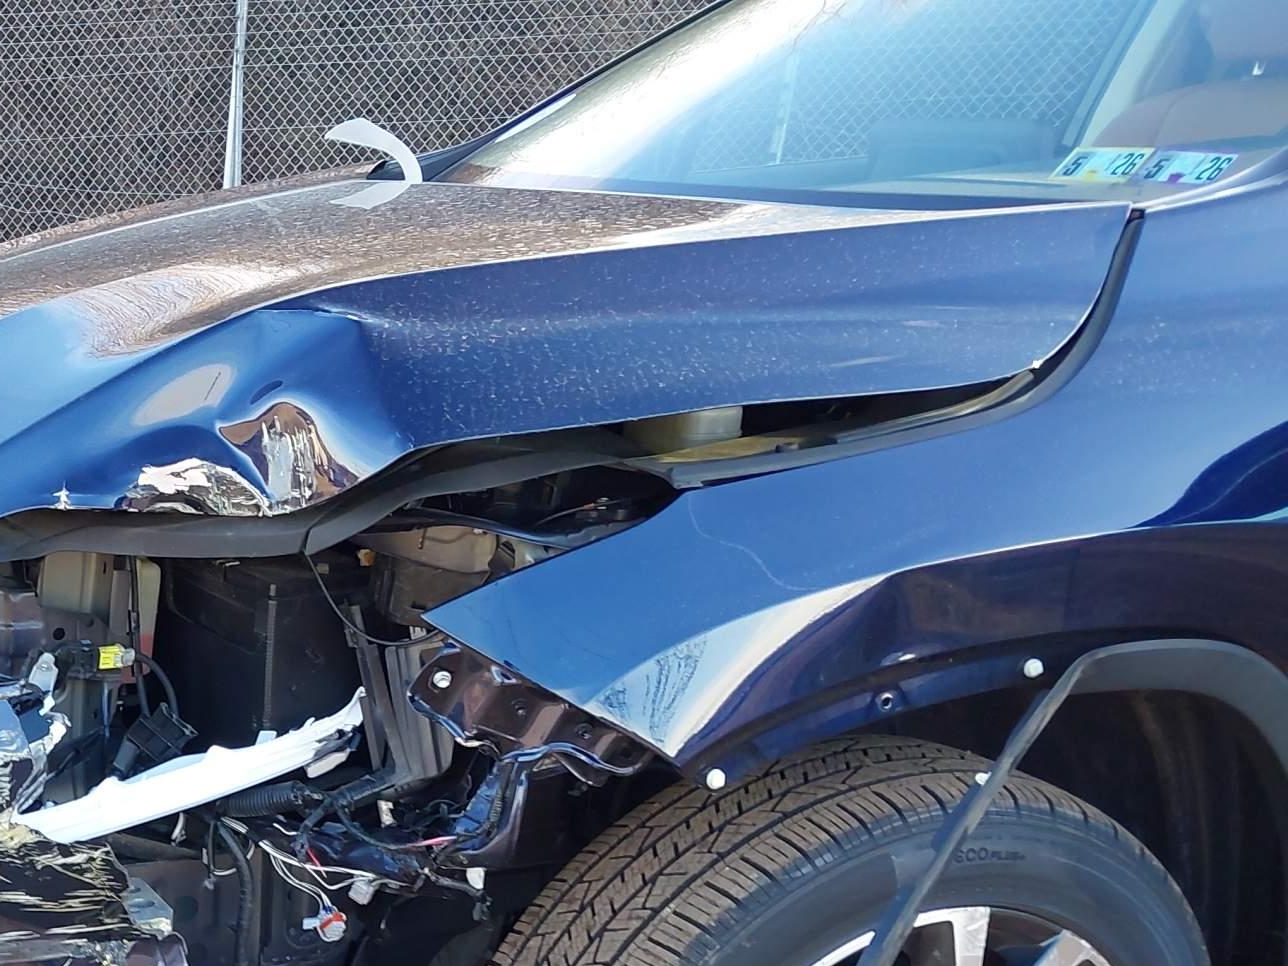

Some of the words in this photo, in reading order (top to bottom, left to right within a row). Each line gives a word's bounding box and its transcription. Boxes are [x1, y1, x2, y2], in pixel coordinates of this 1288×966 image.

[1062, 156, 1088, 177] 5
[1110, 152, 1145, 176] 26
[1194, 156, 1234, 181] 26
